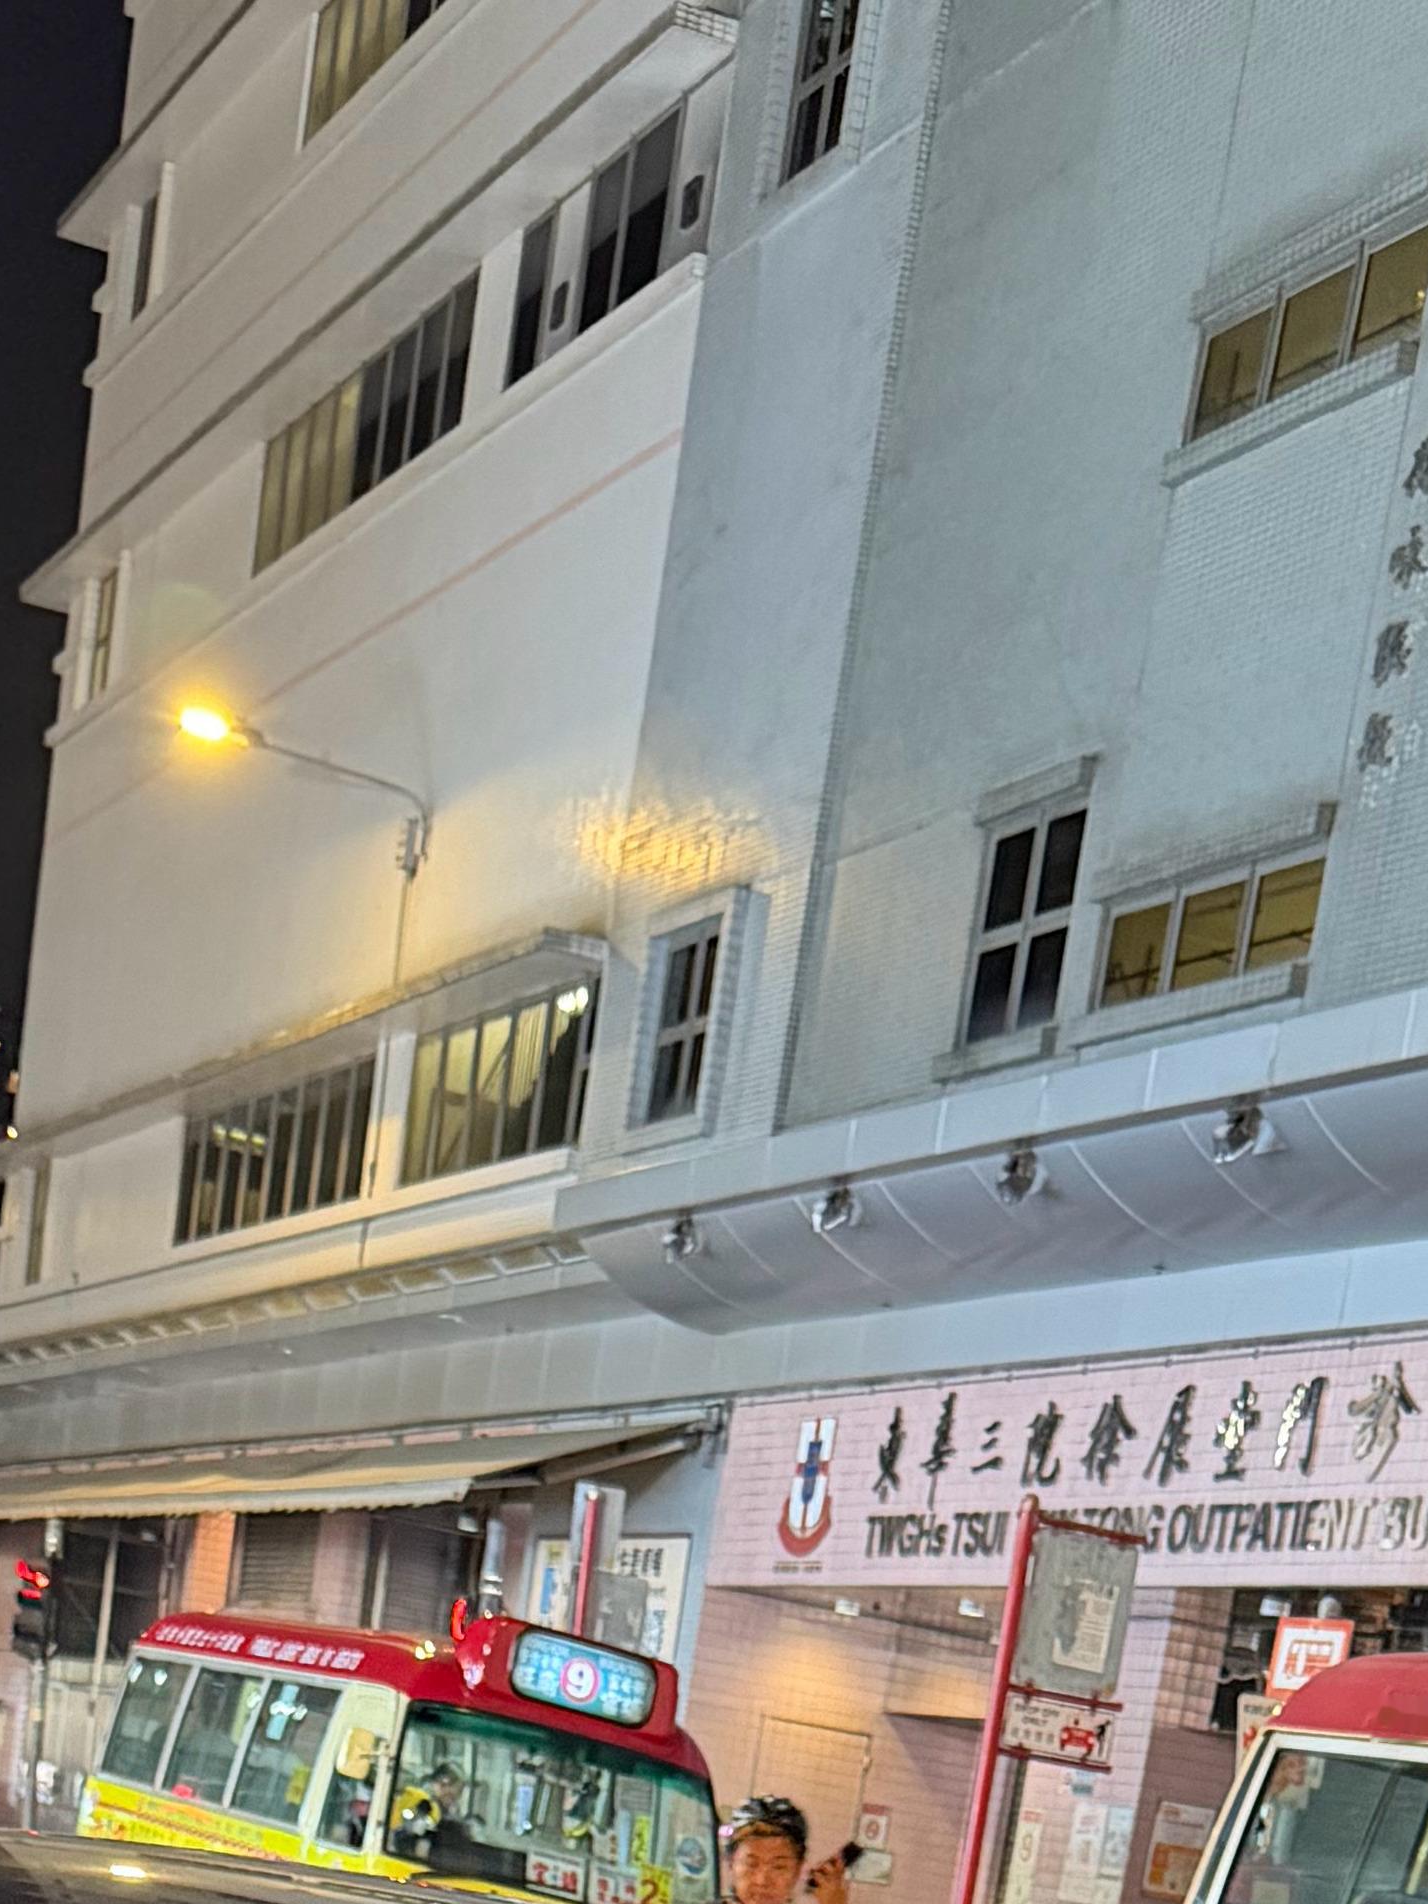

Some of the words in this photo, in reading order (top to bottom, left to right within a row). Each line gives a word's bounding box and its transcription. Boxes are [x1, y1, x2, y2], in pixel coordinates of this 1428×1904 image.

[865, 1512, 947, 1558] TWGHs
[951, 1510, 1009, 1557] TSUI
[1167, 1498, 1373, 1553] OUTPATIENT
[565, 1660, 596, 1699] 9
